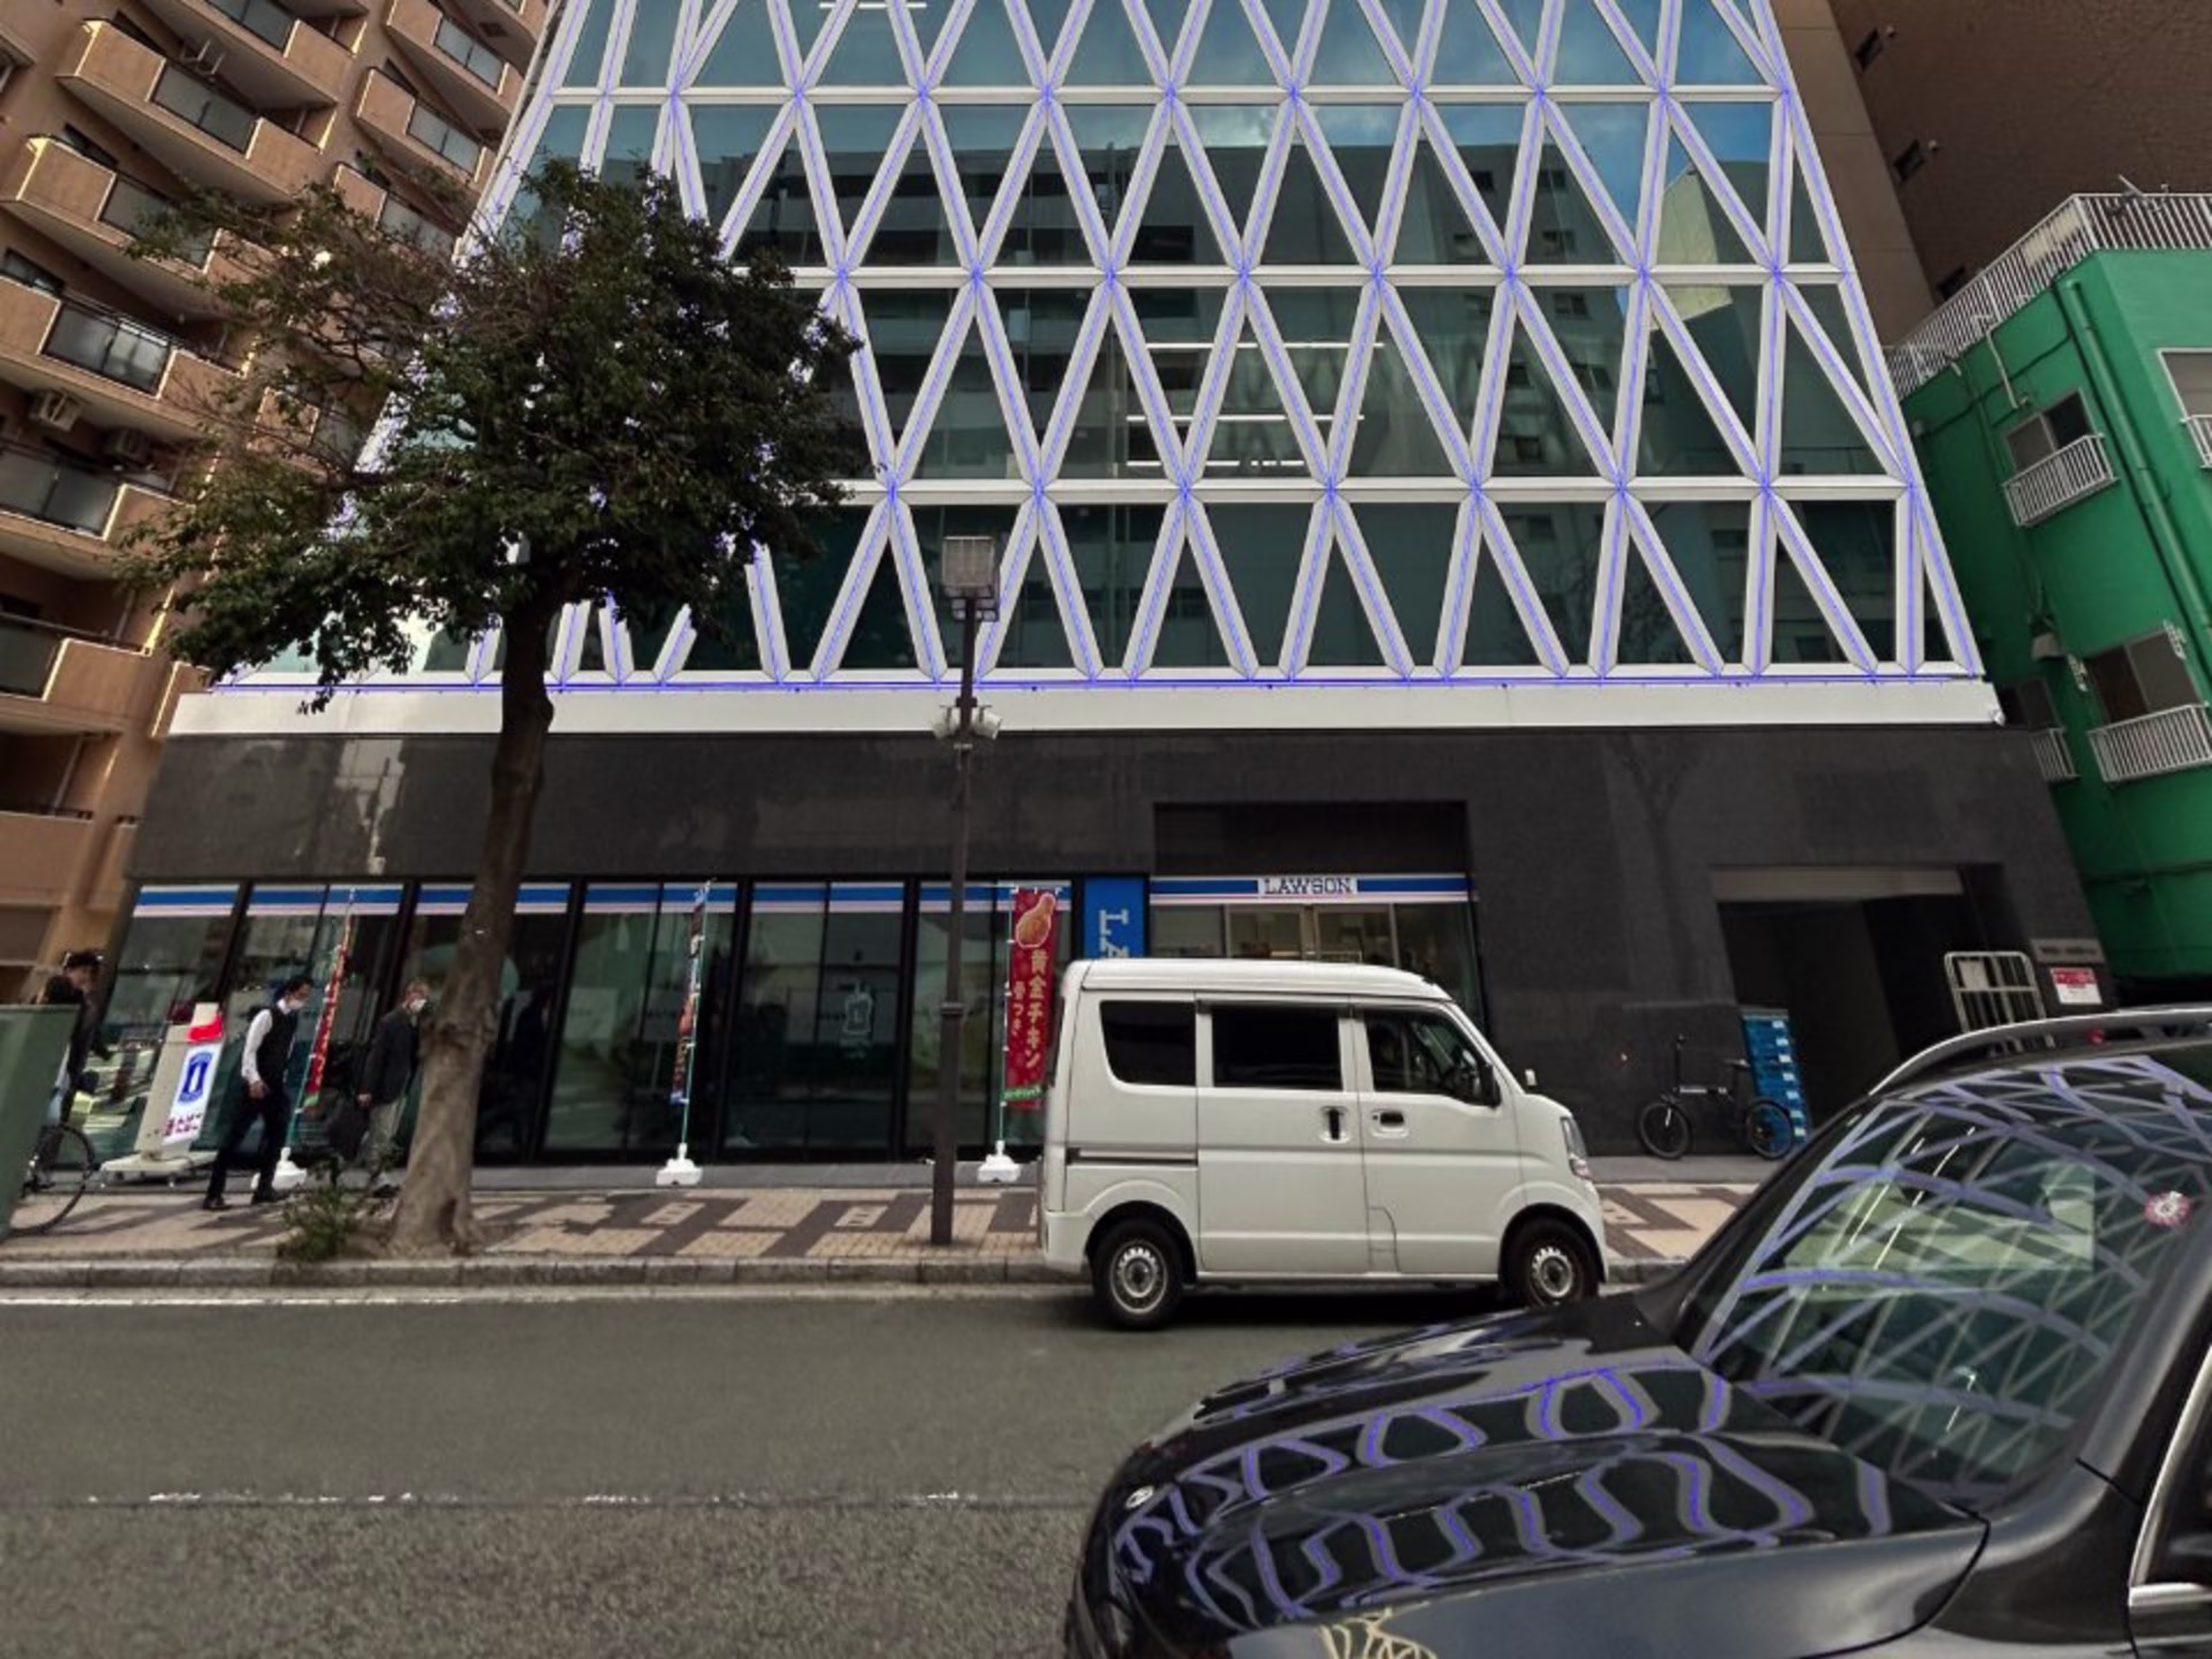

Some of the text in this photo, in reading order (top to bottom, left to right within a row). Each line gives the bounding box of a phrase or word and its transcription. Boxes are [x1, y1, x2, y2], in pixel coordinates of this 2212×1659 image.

[1265, 877, 1352, 894] LAWSON
[1025, 949, 1048, 1068] 黄金チキン
